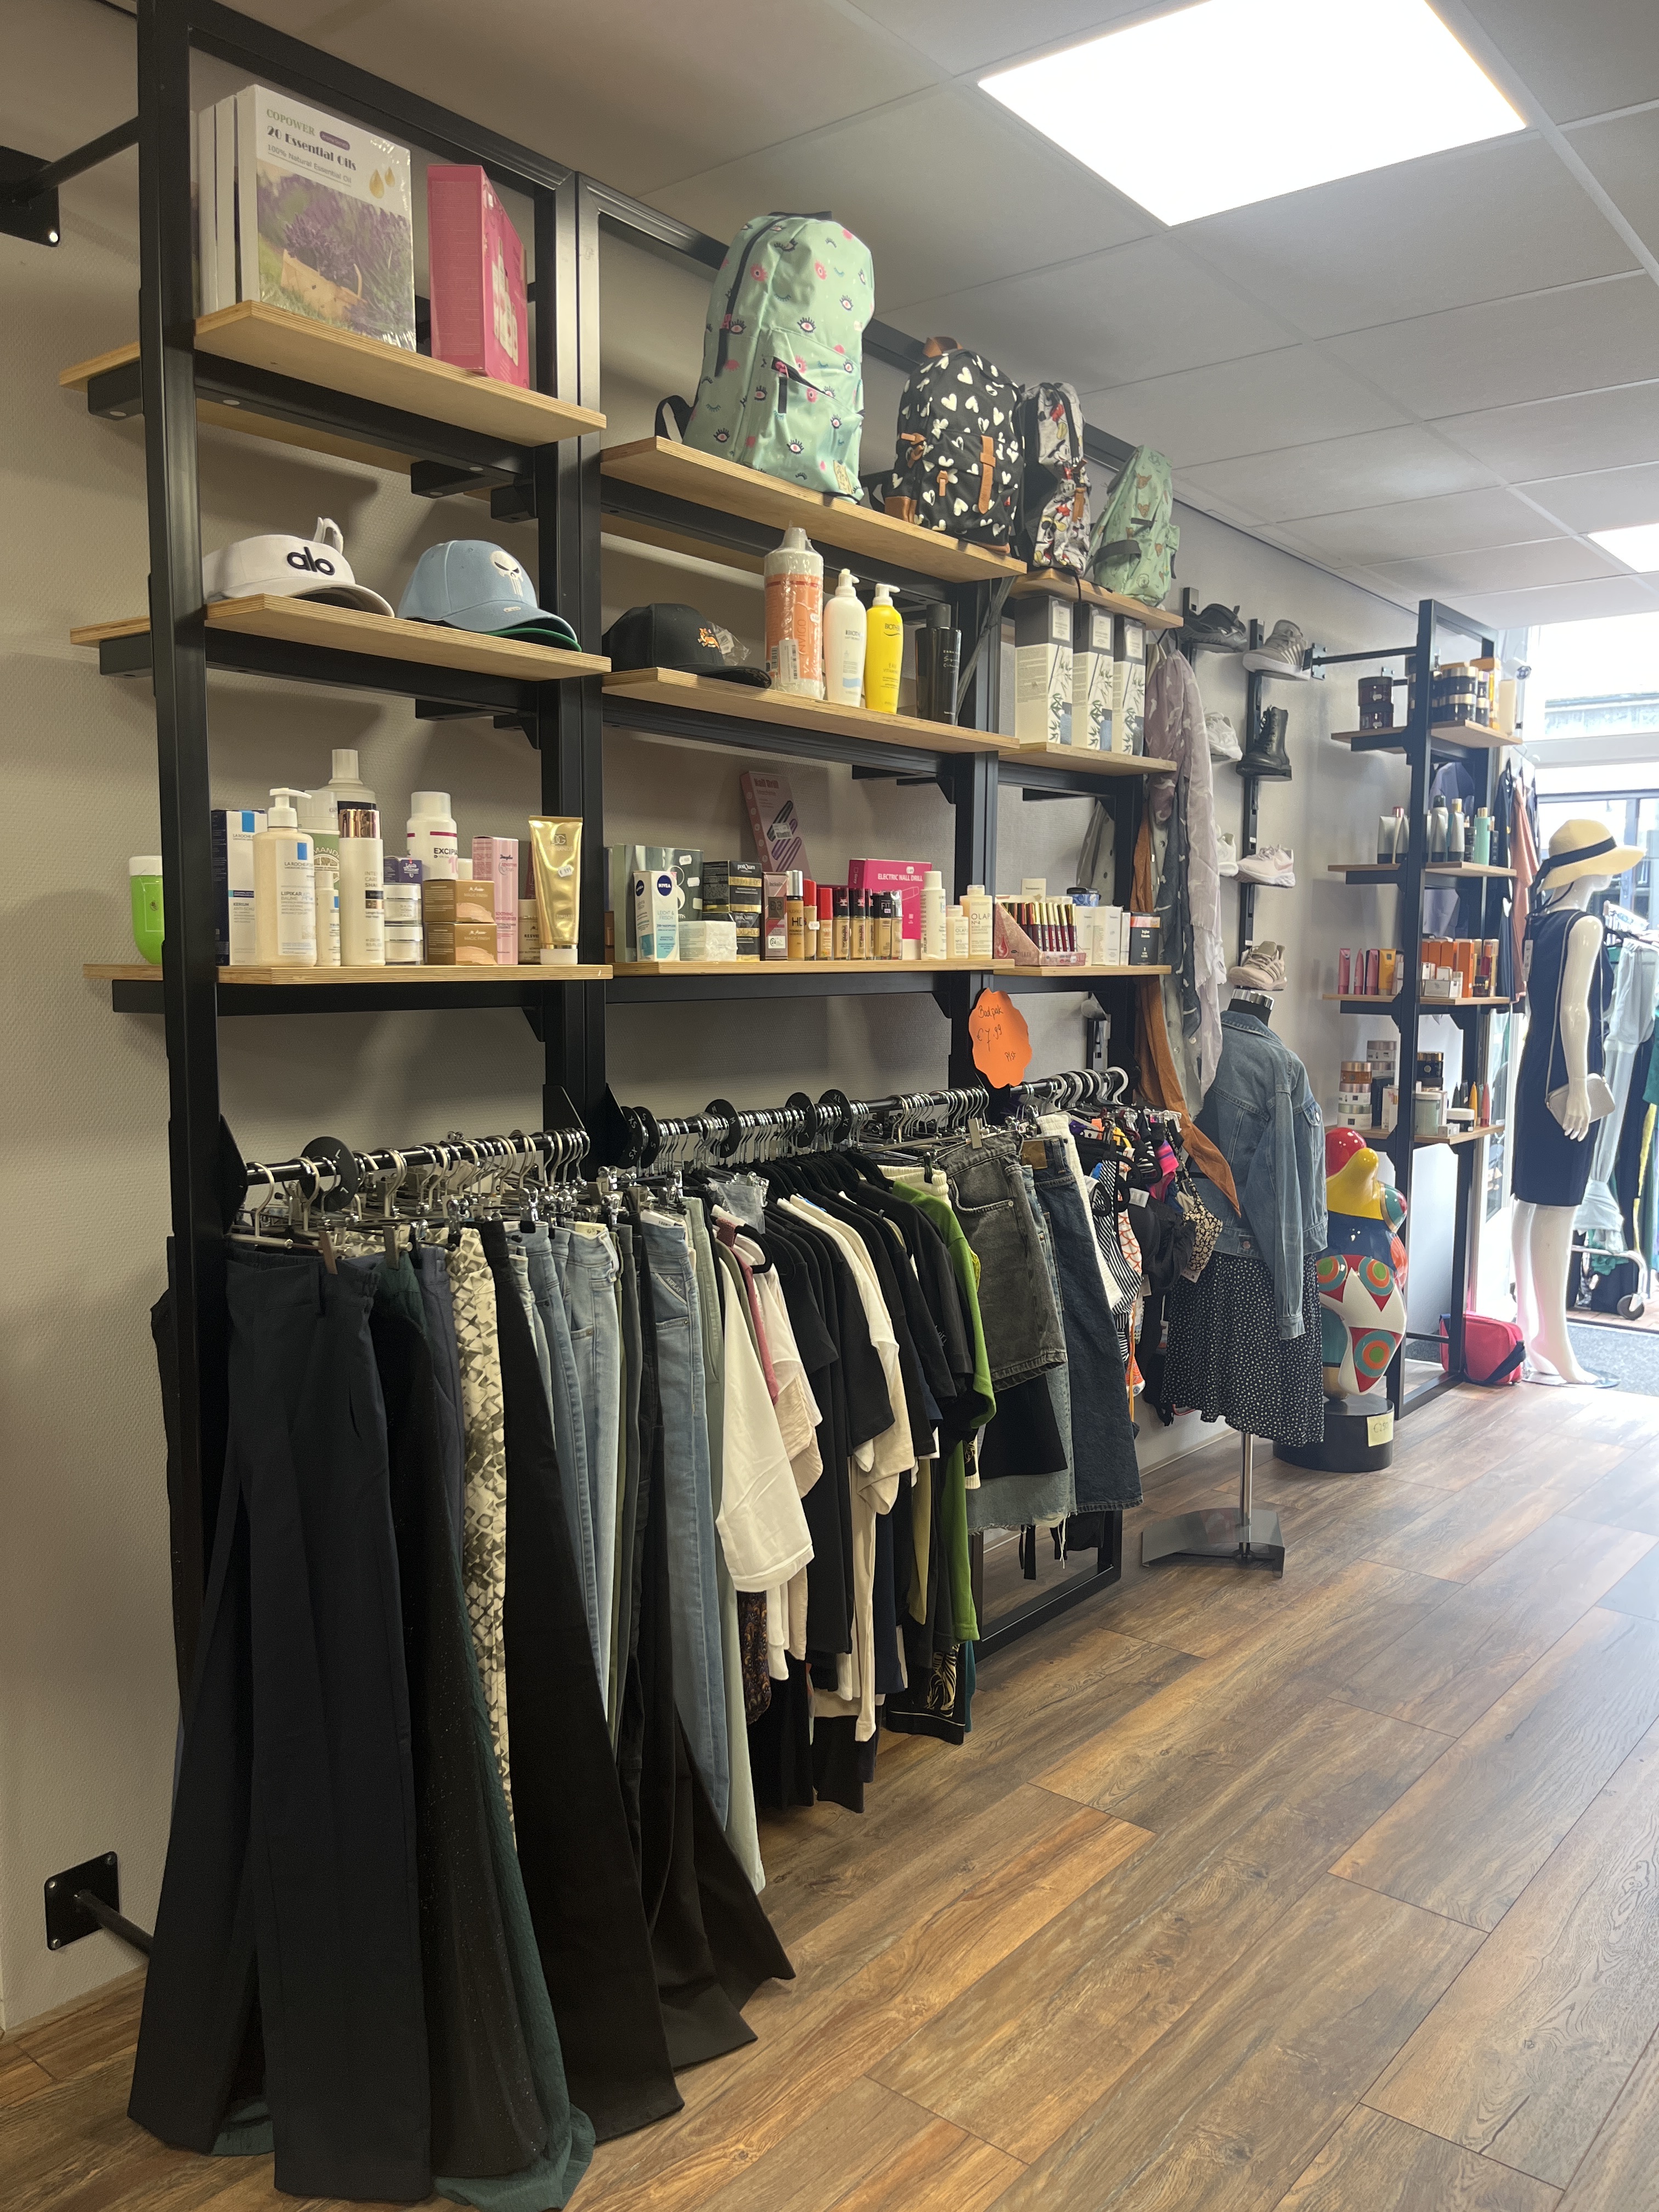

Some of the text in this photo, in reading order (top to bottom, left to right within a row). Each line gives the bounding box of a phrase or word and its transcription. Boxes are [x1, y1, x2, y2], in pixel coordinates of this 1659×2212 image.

[266, 109, 315, 136] COPOWER
[267, 126, 282, 139] 20
[285, 133, 334, 161] Essential
[337, 155, 356, 171] Oils
[268, 144, 286, 157] 100%
[289, 153, 312, 167] Natural
[314, 163, 341, 179] Essential
[286, 546, 336, 575] alo
[833, 1093, 841, 1103] XL
[628, 1115, 637, 1129] XS
[642, 1113, 647, 1121] S
[335, 1149, 341, 1159] L
[629, 1146, 637, 1160] XS
[665, 1276, 682, 1293] REPLAY
